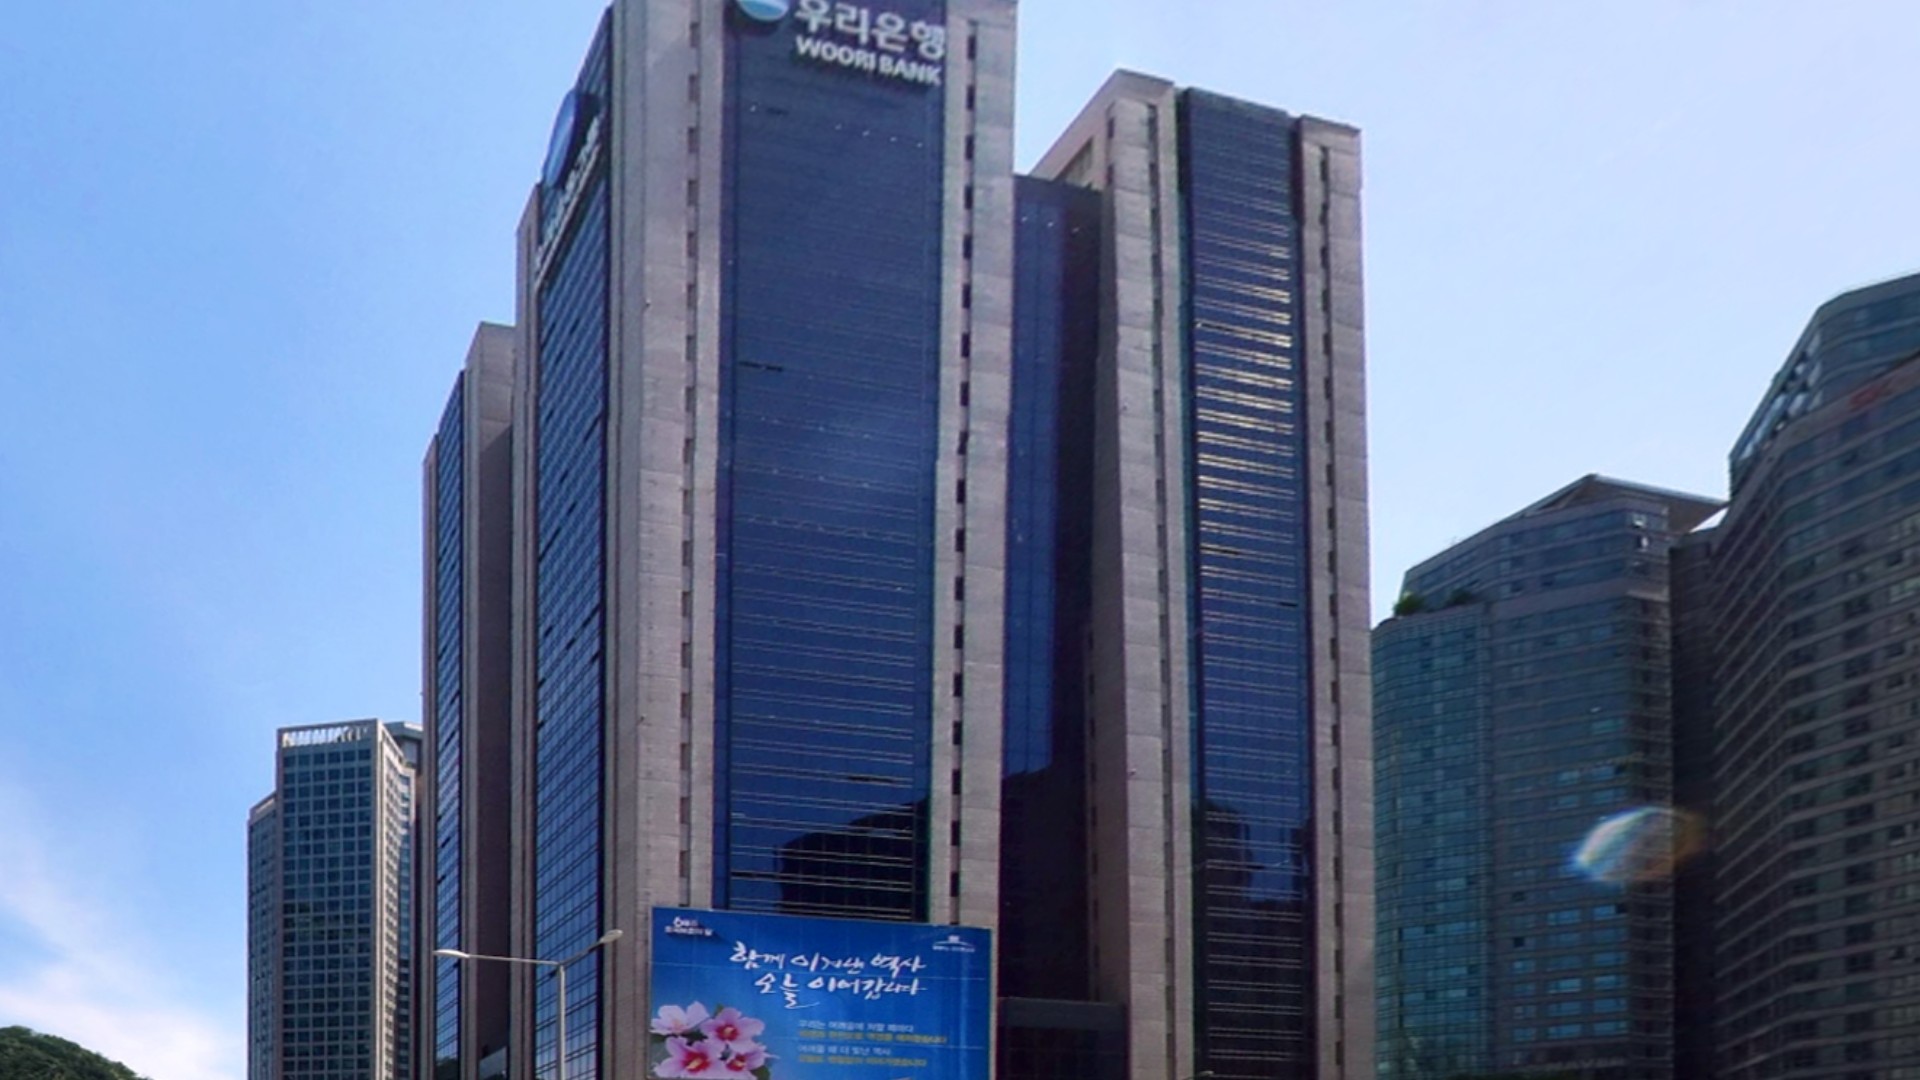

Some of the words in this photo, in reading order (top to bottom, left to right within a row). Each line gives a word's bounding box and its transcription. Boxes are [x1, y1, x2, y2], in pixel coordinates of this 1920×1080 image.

[794, 0, 945, 60] 우리은행
[796, 35, 876, 72] WOORI
[879, 55, 942, 85] BANK
[730, 941, 786, 970] 함께
[870, 952, 926, 978] 역사
[754, 973, 816, 1009] 오늘
